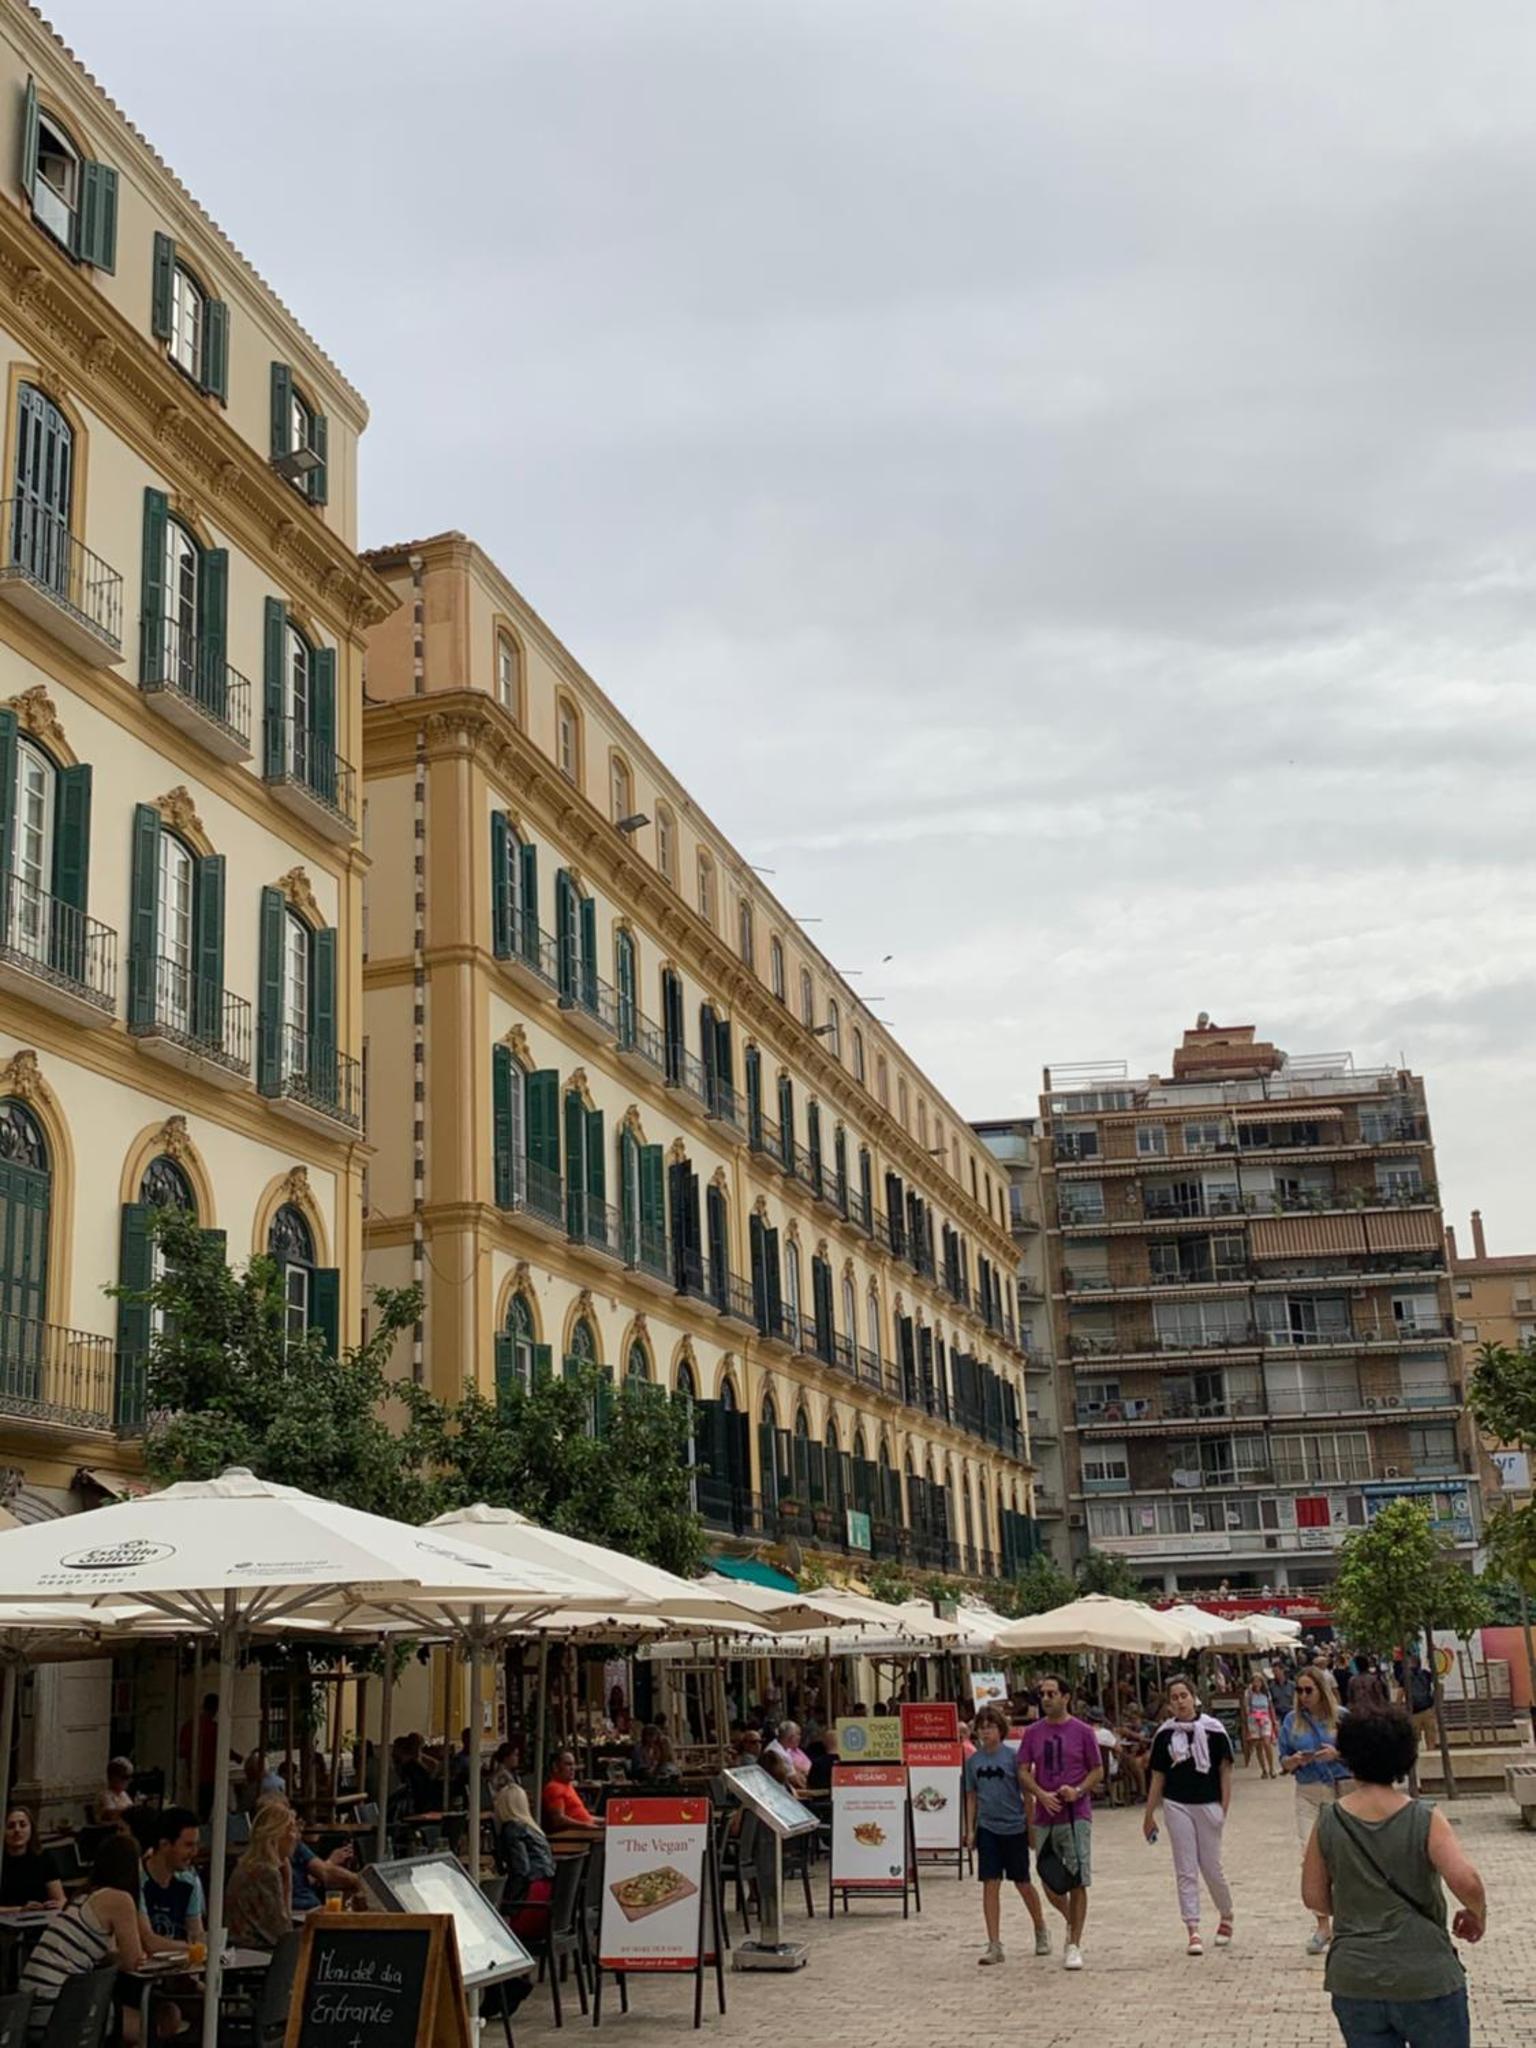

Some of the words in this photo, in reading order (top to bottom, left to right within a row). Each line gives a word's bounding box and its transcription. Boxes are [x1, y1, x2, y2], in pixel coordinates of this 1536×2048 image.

[853, 1773, 887, 1781] VEGANO
[351, 1959, 376, 1981] del
[311, 1994, 394, 2023] Entrante
